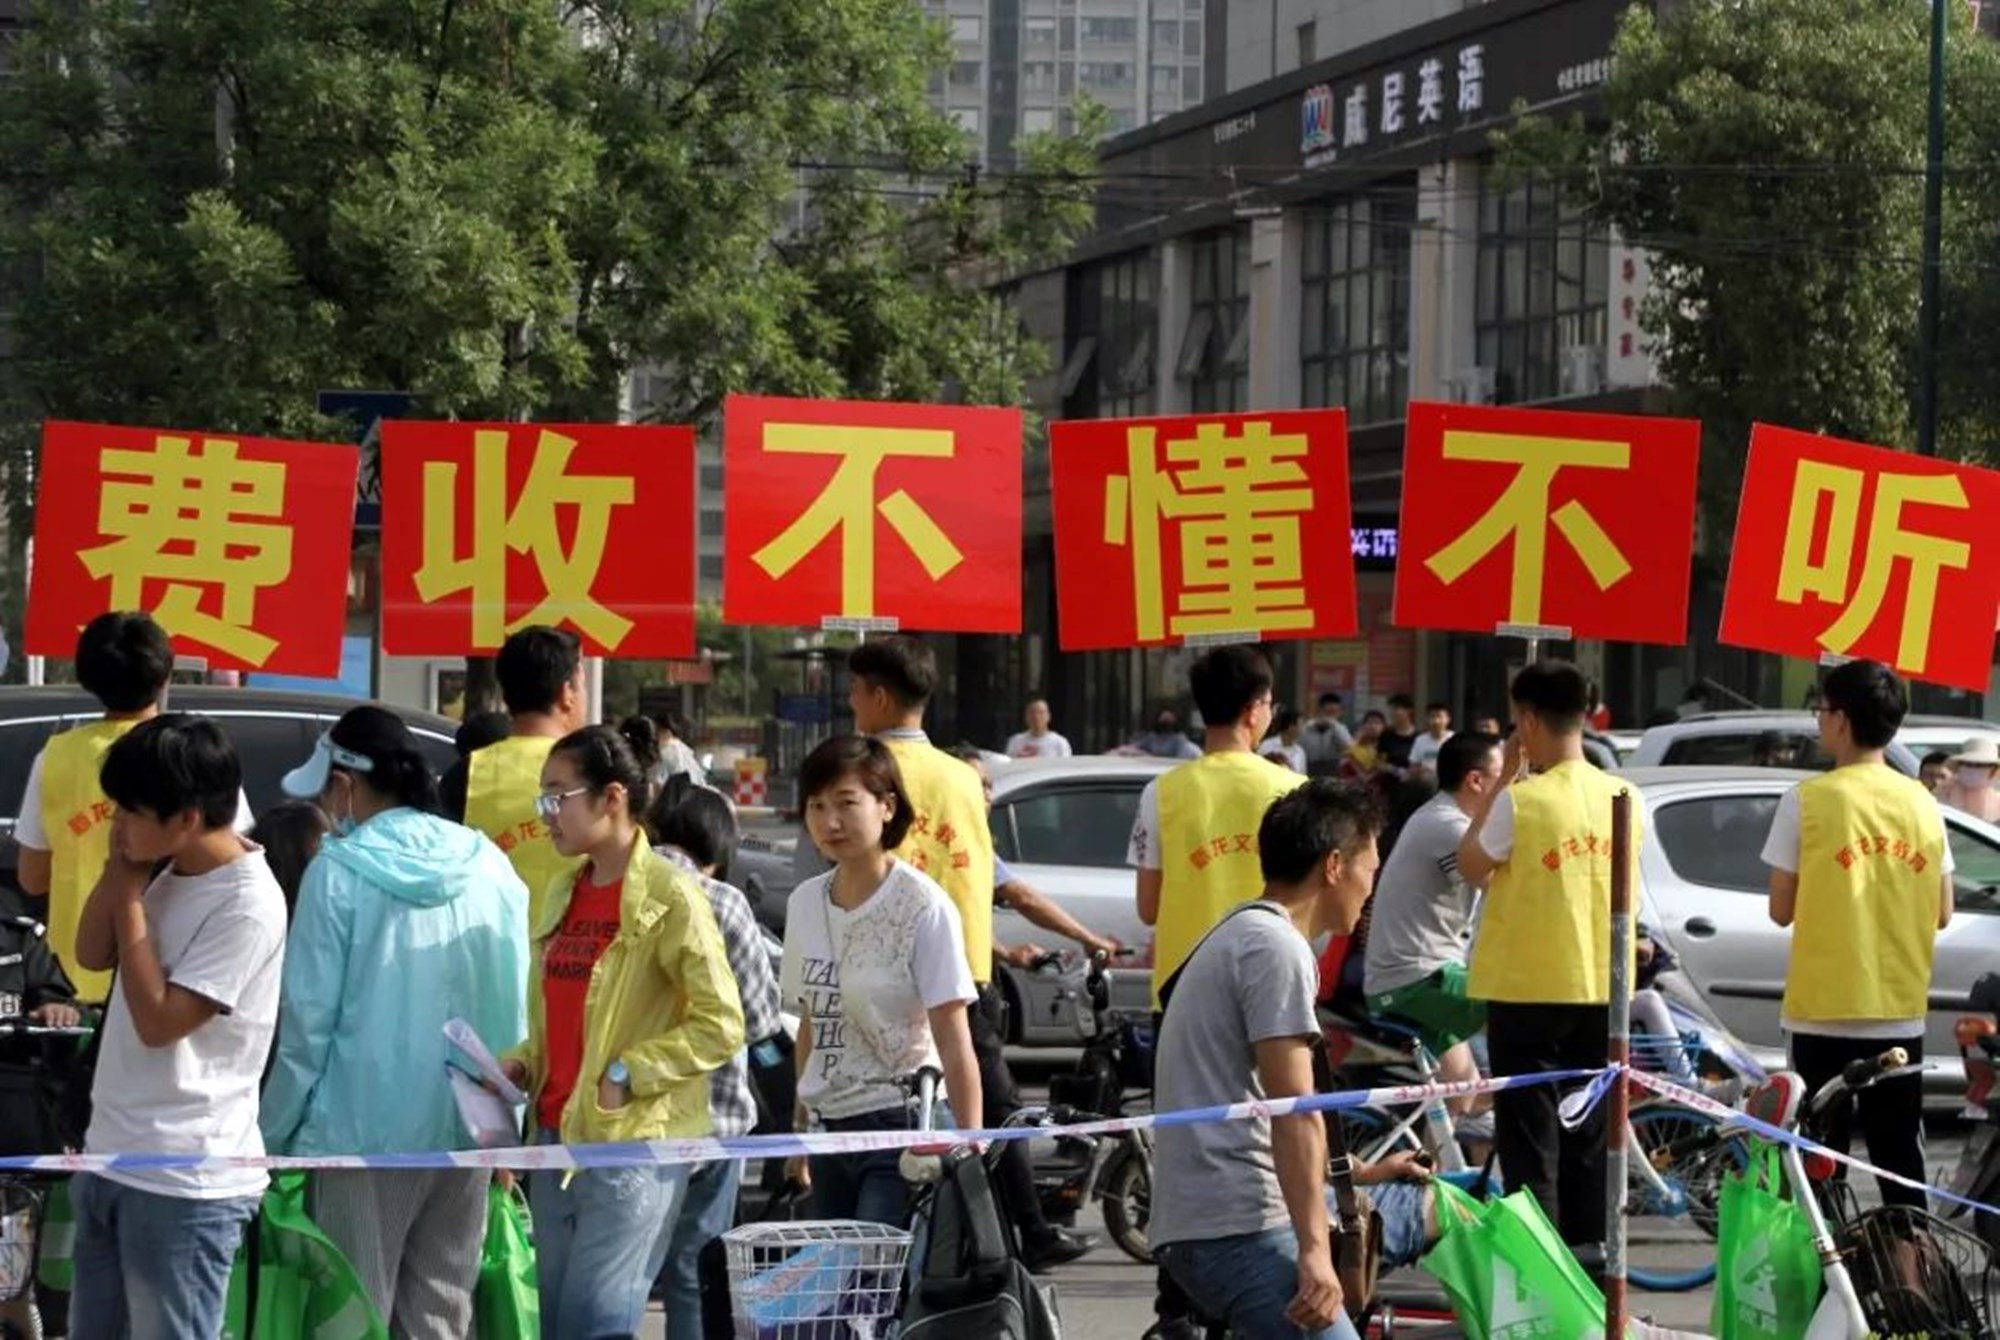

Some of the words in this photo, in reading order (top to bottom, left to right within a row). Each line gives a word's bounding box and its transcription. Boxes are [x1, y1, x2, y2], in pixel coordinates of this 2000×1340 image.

[76, 436, 294, 668] 费
[413, 429, 636, 652] 收
[750, 422, 964, 619] 不
[1104, 422, 1315, 641] 懂
[1424, 430, 1631, 626] 不
[1776, 458, 1971, 674] 听
